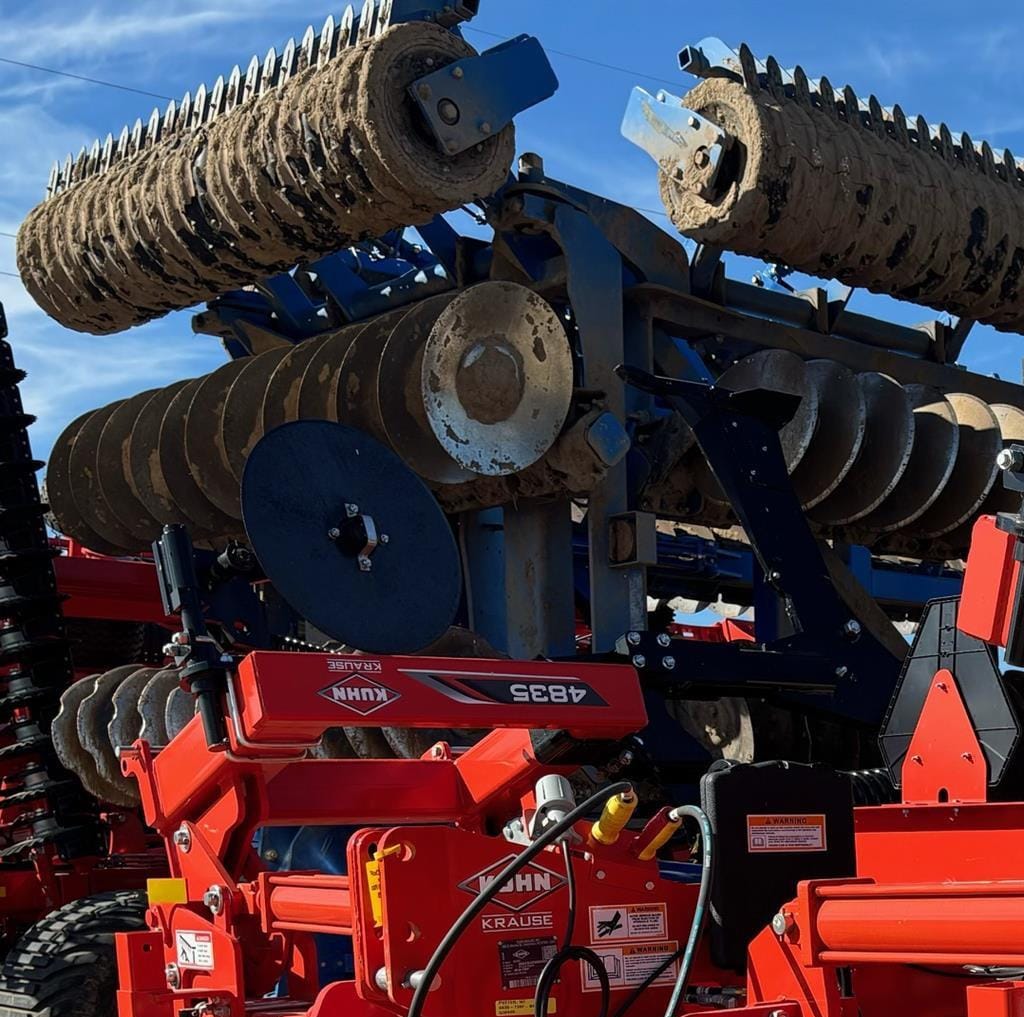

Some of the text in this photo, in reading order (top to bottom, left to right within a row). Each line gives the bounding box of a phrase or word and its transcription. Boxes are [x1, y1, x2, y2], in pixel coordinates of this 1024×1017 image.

[327, 660, 382, 672] KRAUSE
[331, 686, 388, 701] KUHN
[510, 683, 587, 703] 4835
[481, 914, 553, 929] KRAUSE
